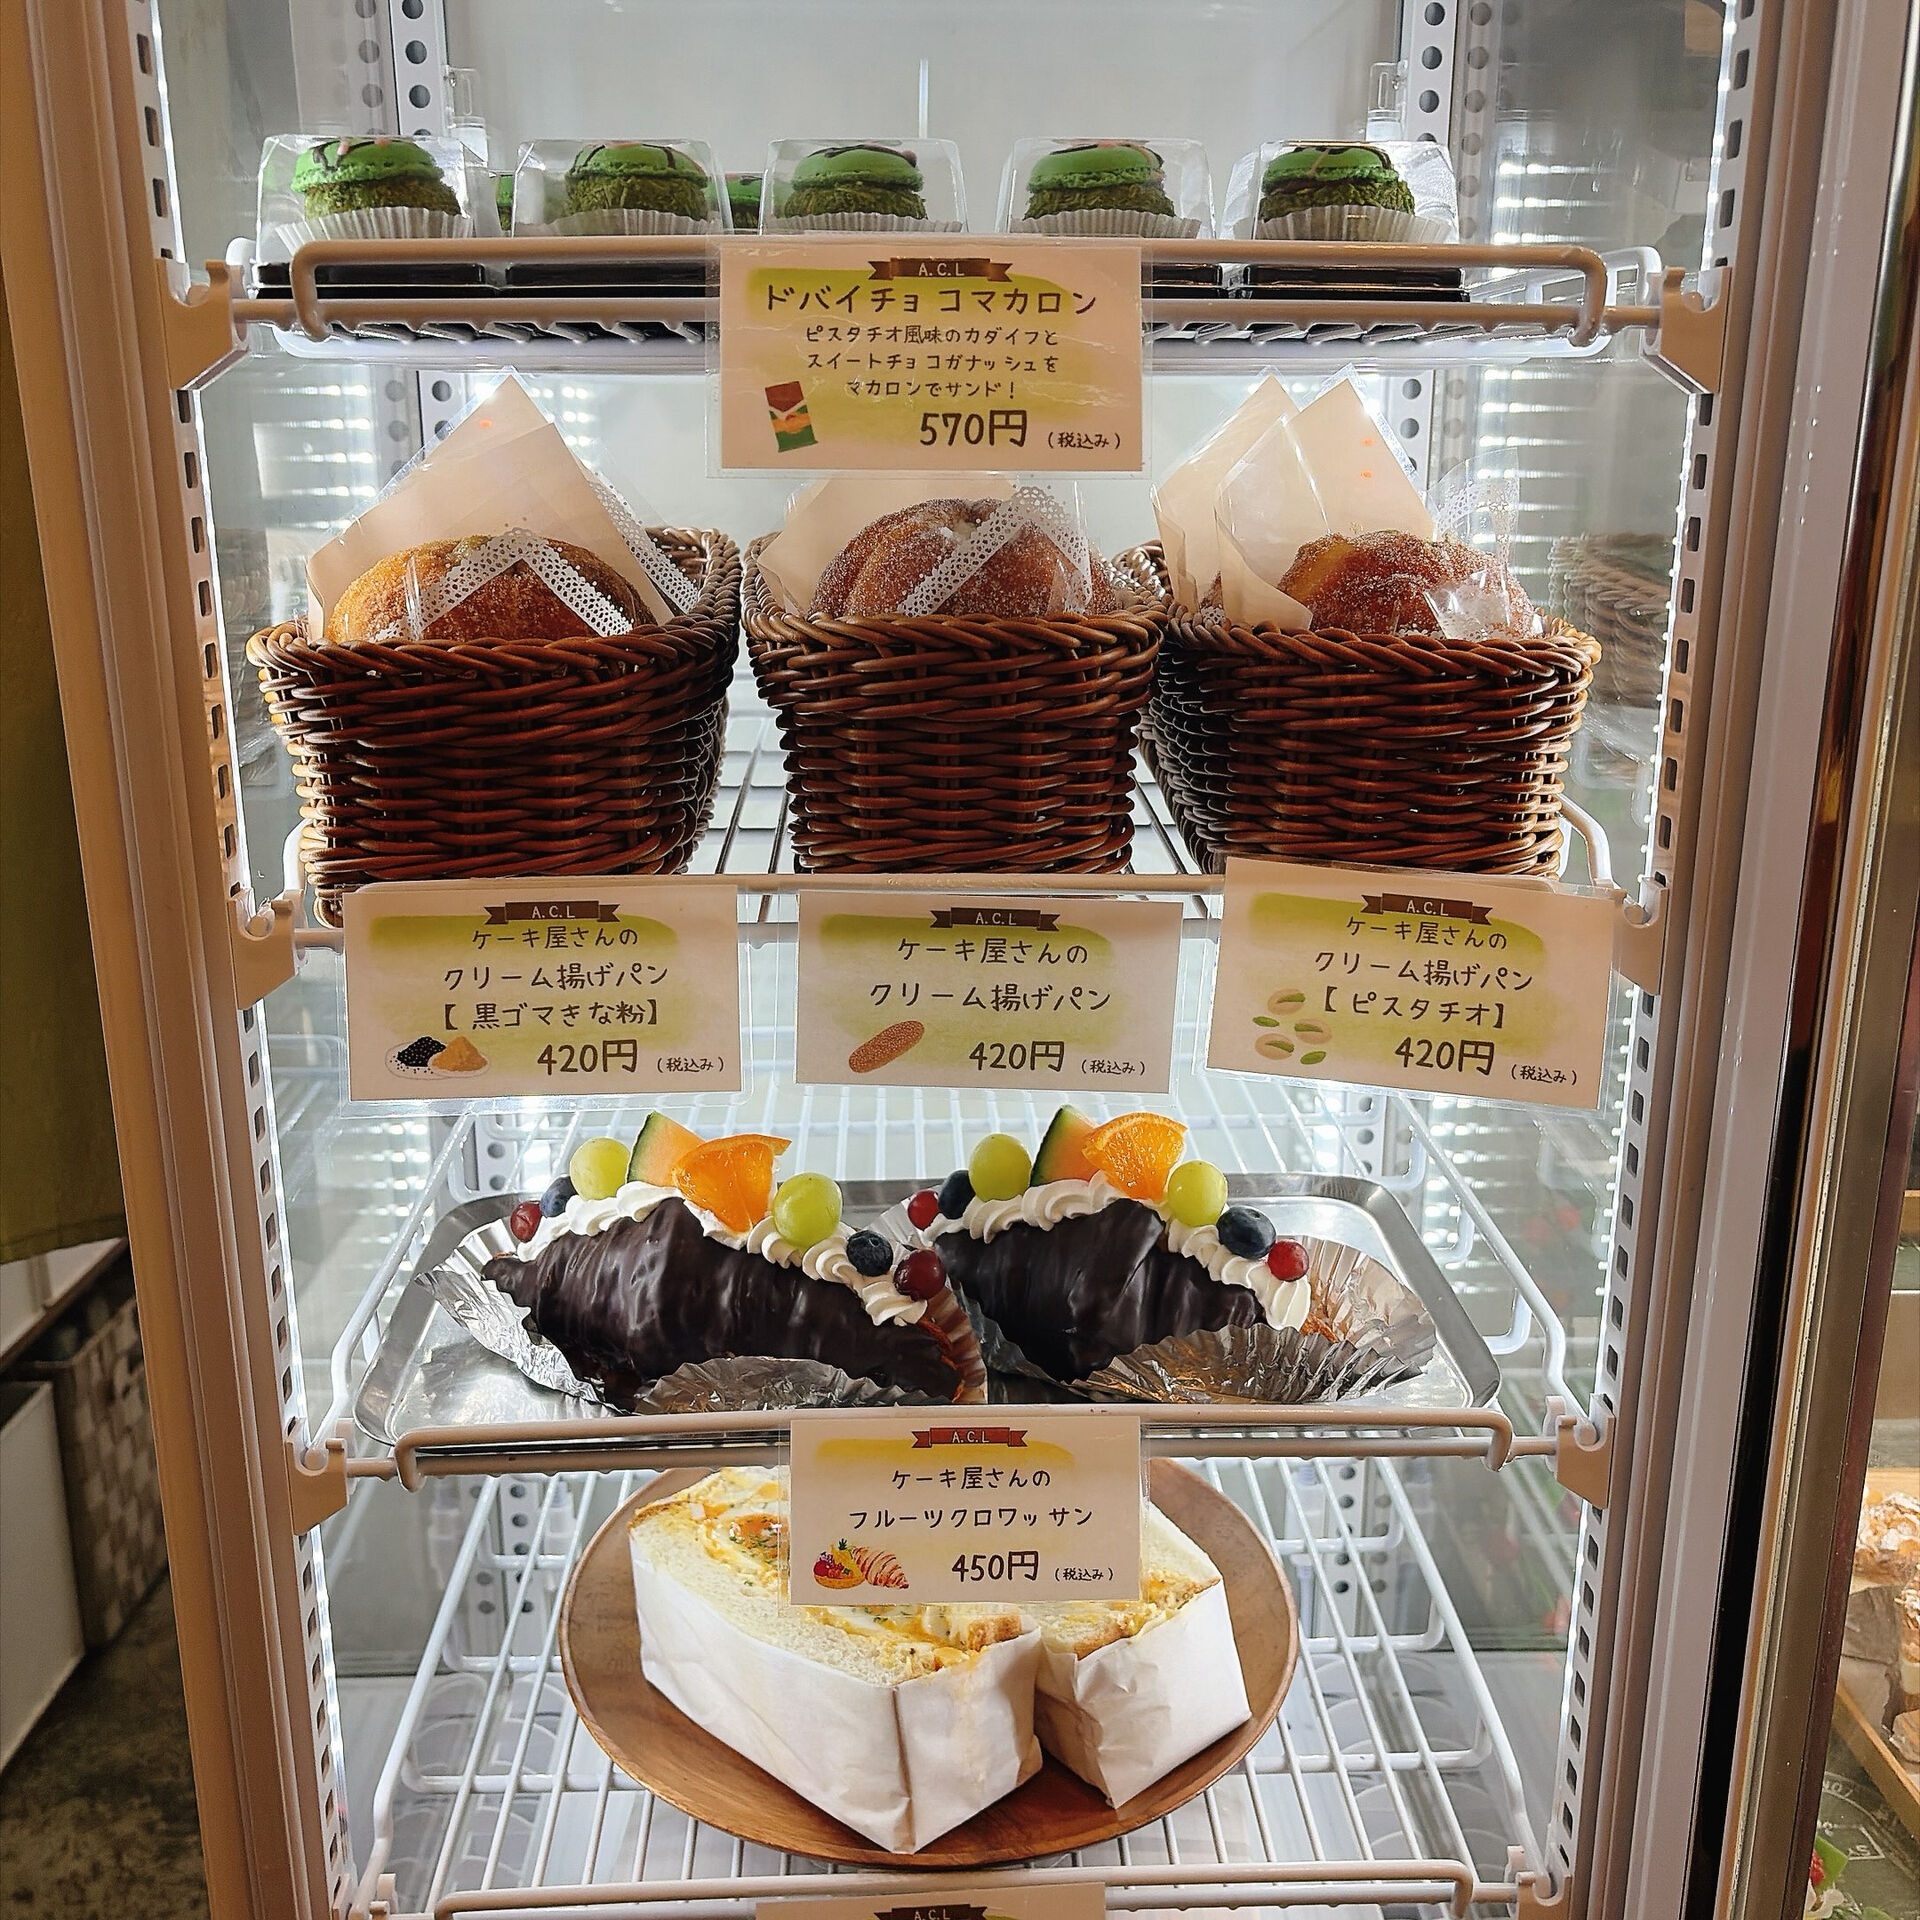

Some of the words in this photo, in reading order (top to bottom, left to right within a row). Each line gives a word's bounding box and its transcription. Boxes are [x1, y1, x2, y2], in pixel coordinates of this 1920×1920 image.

[918, 263, 964, 277] A.C.L
[767, 284, 1096, 316] ドバイチョコマカロン
[807, 325, 1059, 346] ピスタチオ風味のカダイフと
[809, 353, 1057, 372] スイートチョコガナッシュを
[848, 379, 1015, 400] マカロンでサンド！
[920, 410, 1027, 447] 570円
[532, 905, 576, 920] A.C.L
[976, 913, 1017, 926] A.C.L
[1407, 900, 1449, 916] A.C.L
[472, 925, 638, 950] ケーキ屋さんの
[1346, 917, 1507, 950] ケーキ屋さんの
[898, 938, 1088, 964] ケーキ屋さんの
[444, 962, 668, 990] クリーム揚げパン
[1315, 951, 1533, 991] クリーム揚げパン
[870, 983, 1110, 1011] クリーム揚げパン
[1324, 986, 1504, 1028] 【ピスタチオ】
[445, 999, 657, 1031] 【黒ゴマきな粉】
[537, 1039, 638, 1075] 420円
[969, 1041, 1064, 1071] 420円
[1395, 1037, 1495, 1075] 420円
[952, 1431, 989, 1443] A.C.L
[892, 1467, 1050, 1489] ケーキ屋さんの
[849, 1508, 1092, 1528] フルーツクロワッサン
[952, 1551, 1039, 1582] 450円
